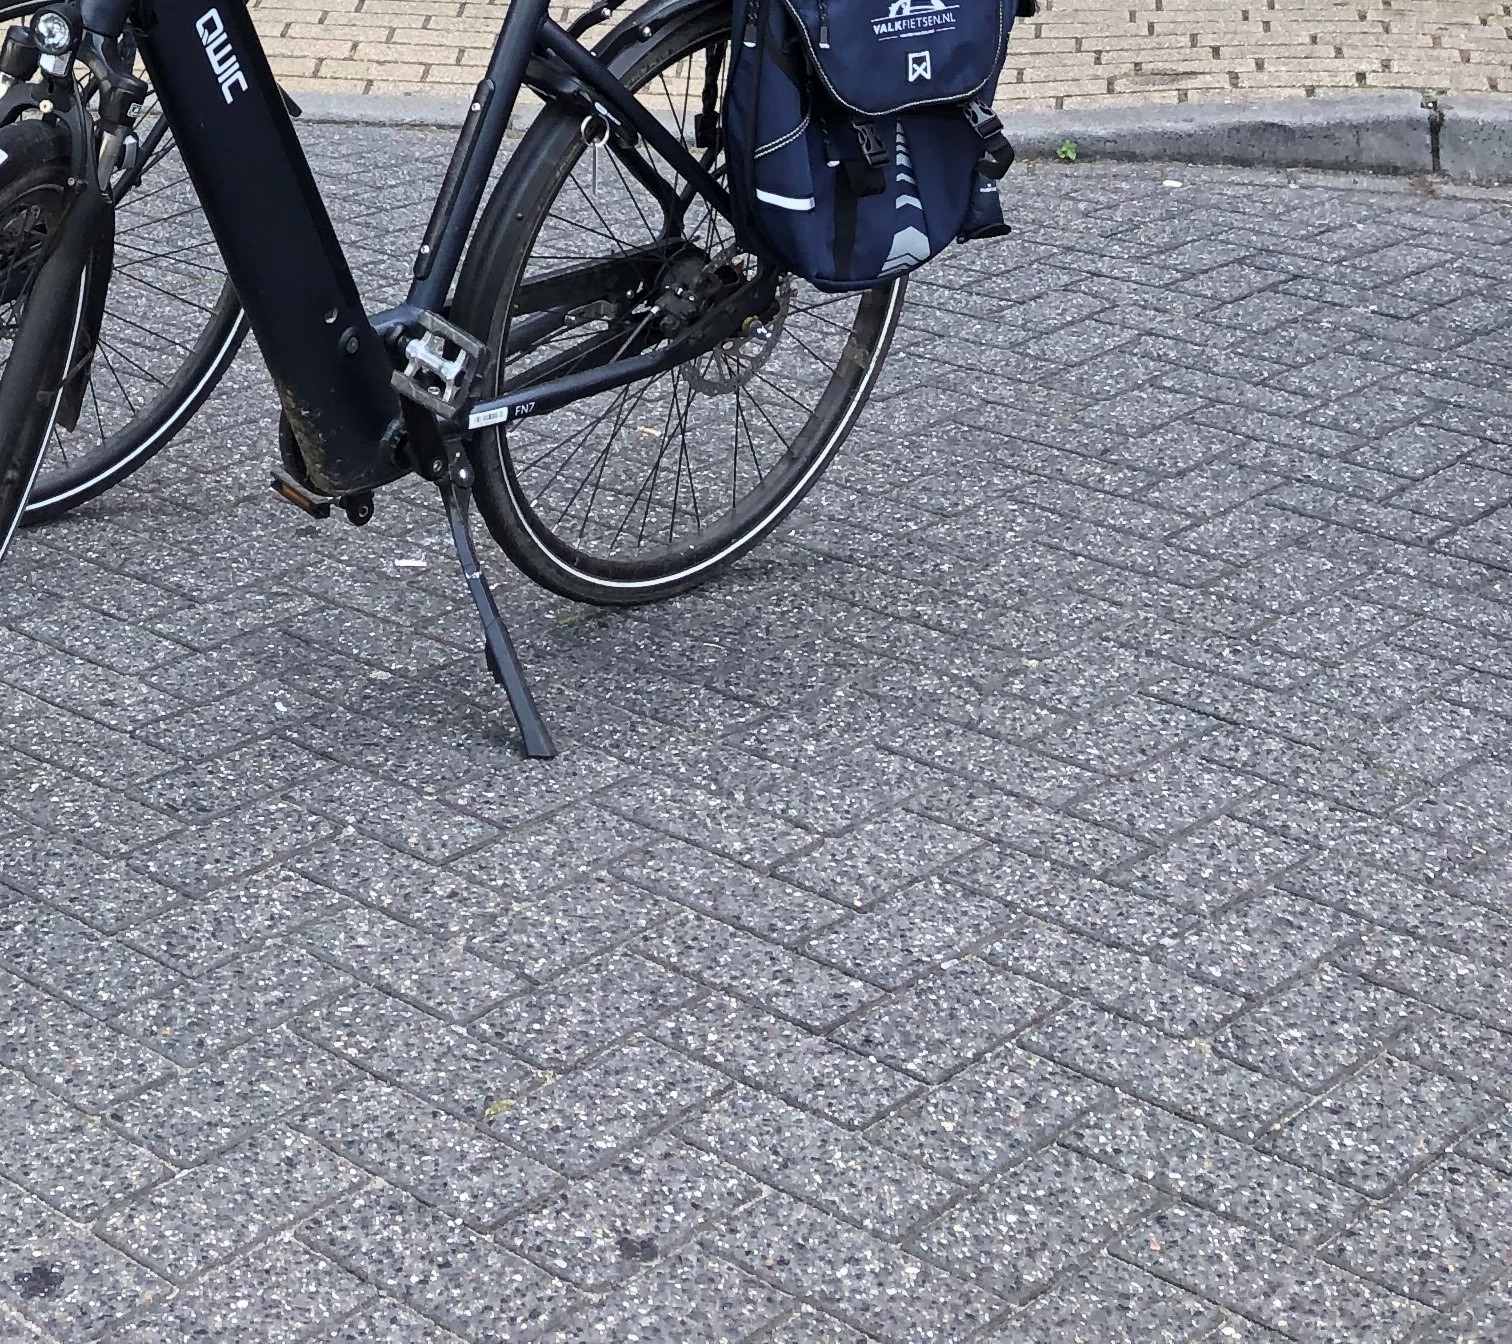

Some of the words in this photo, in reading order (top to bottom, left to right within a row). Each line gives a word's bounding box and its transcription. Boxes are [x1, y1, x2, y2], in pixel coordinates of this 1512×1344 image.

[873, 12, 957, 35] VALKFIETSEN.NL
[196, 7, 249, 105] QWIC
[515, 401, 536, 417] FN7
